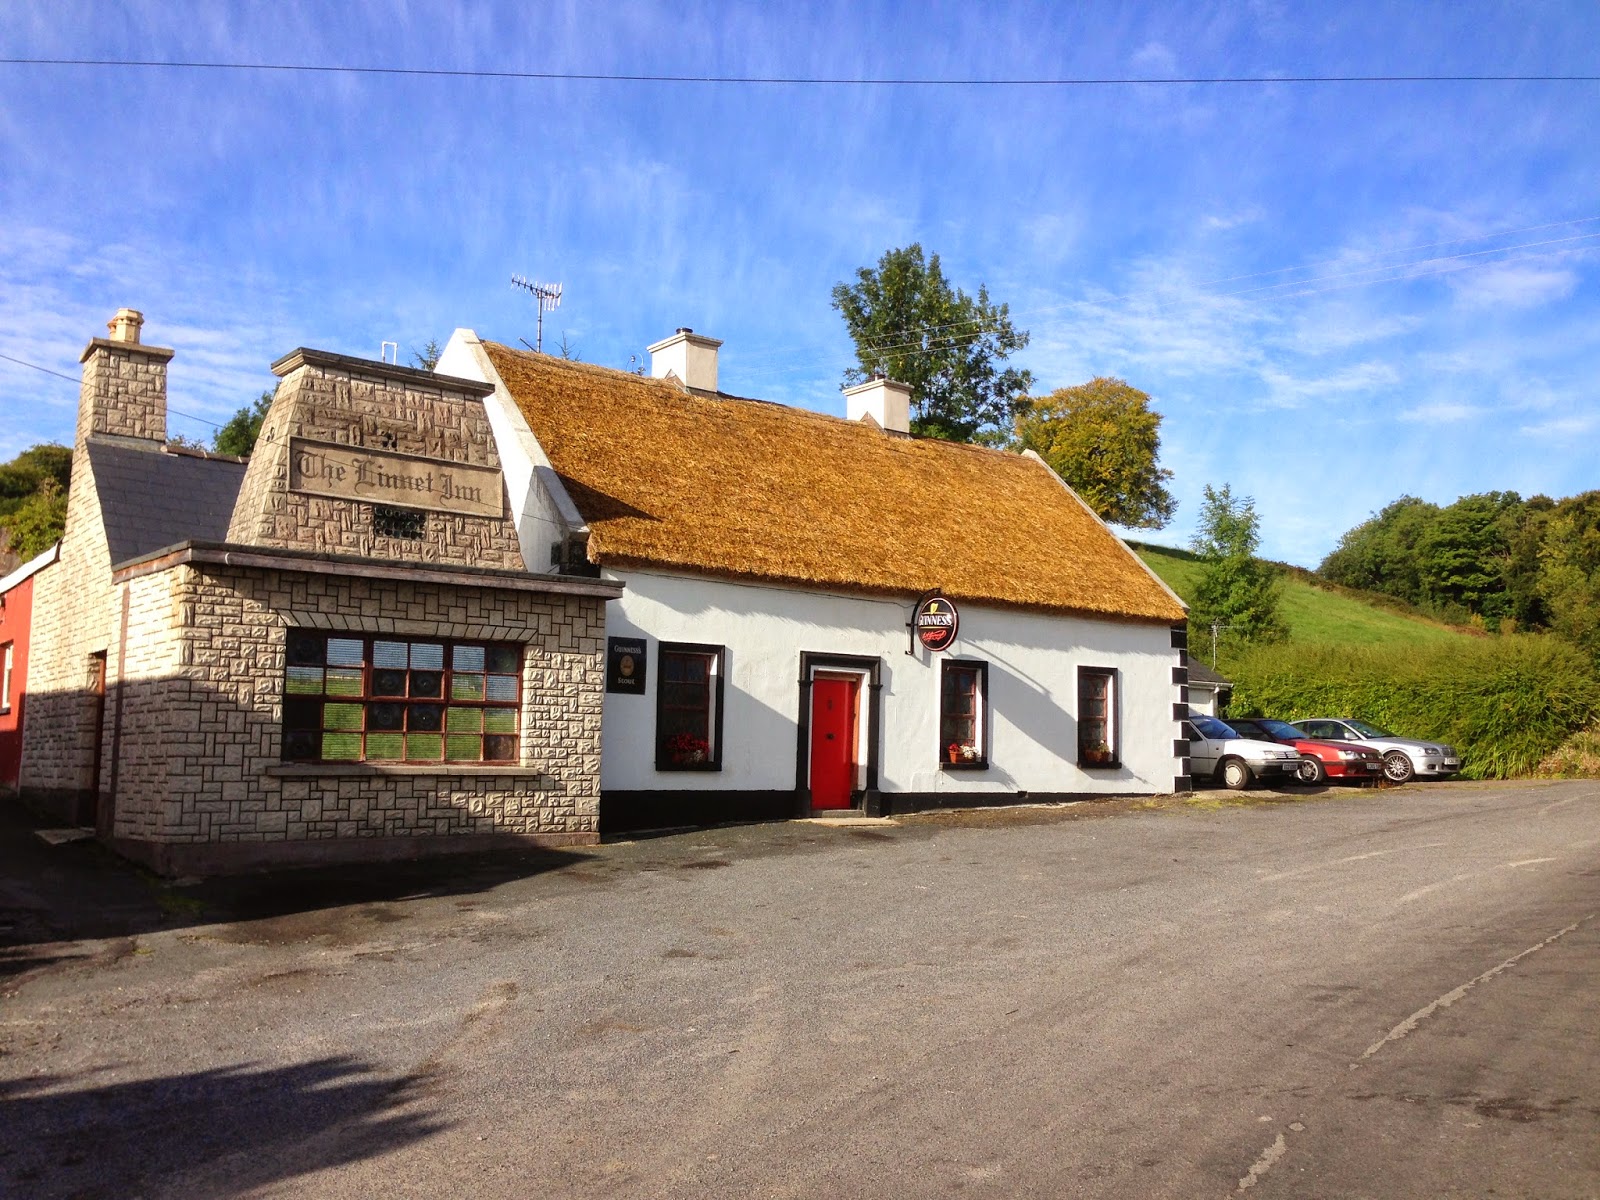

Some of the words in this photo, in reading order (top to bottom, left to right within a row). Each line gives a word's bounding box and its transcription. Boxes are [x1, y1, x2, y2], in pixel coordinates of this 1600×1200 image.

[295, 450, 346, 488] The
[351, 457, 434, 494] Linnet
[439, 473, 482, 506] Inn
